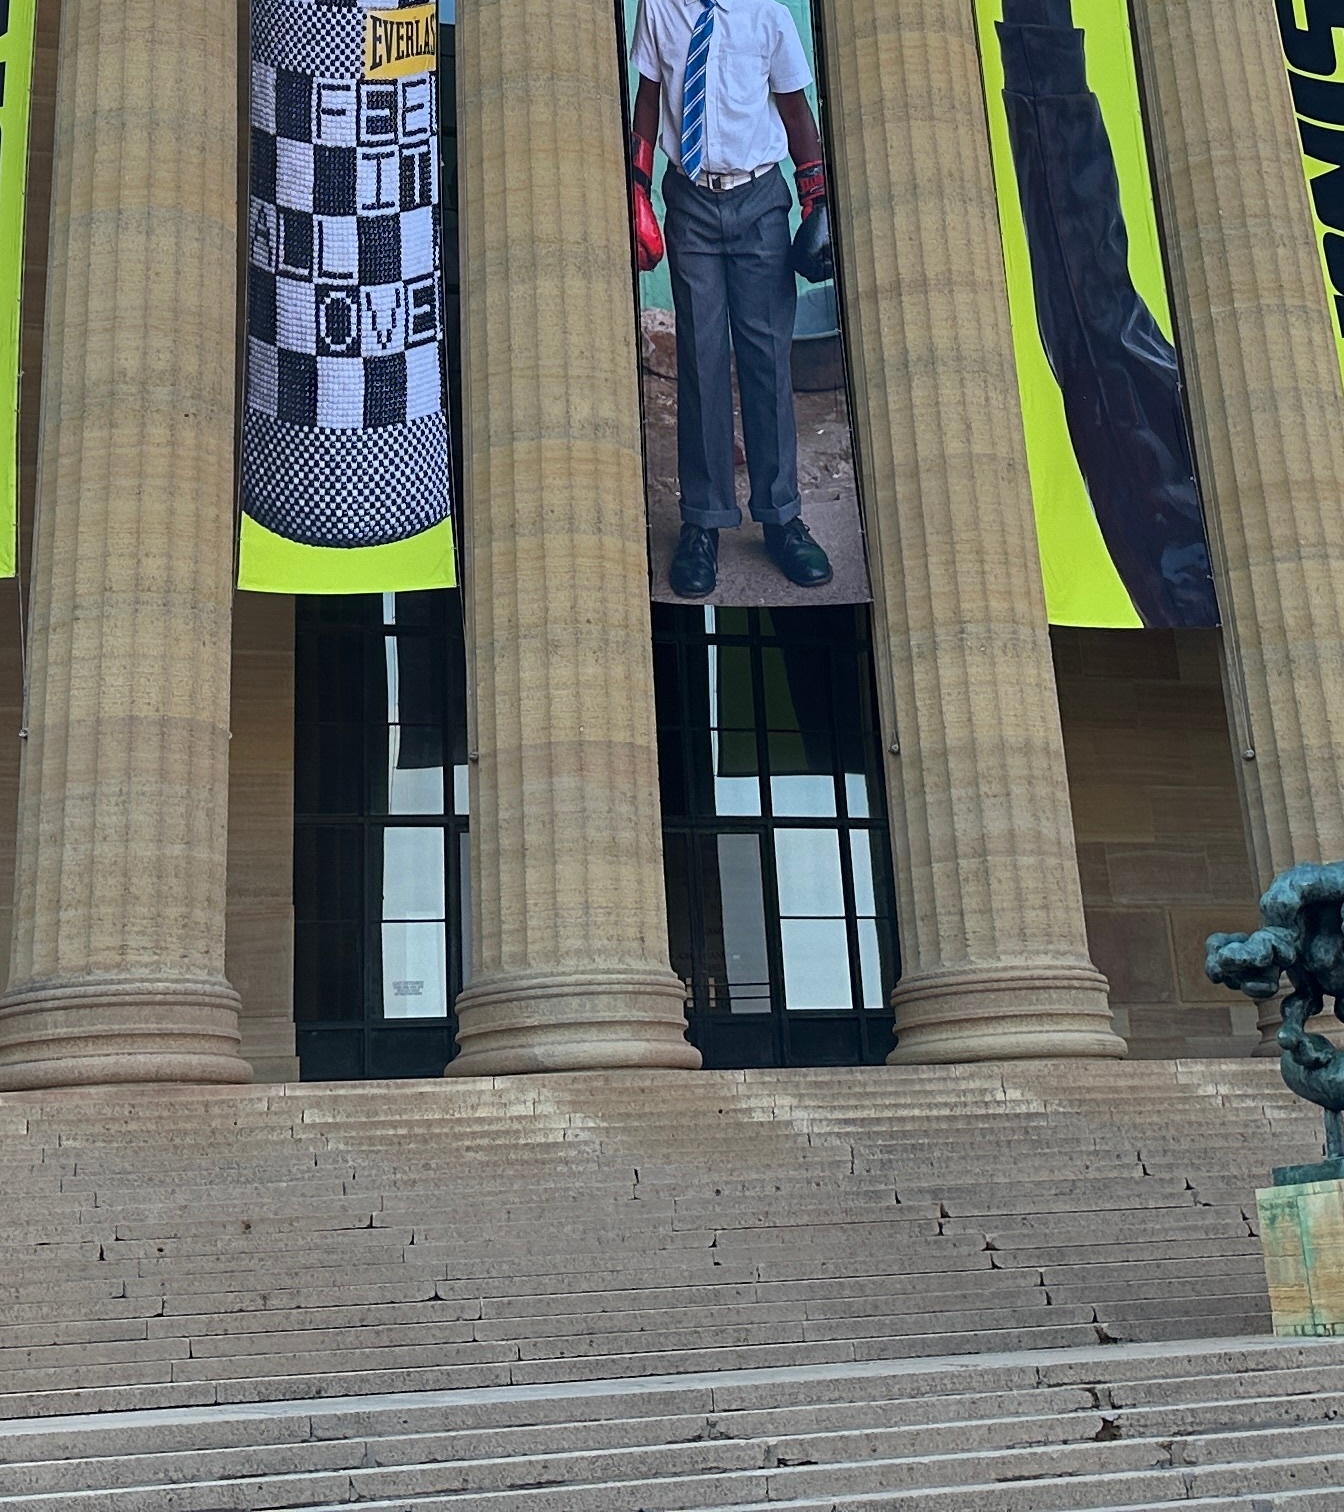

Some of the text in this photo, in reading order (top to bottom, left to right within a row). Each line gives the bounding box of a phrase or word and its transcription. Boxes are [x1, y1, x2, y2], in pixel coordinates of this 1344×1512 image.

[370, 13, 435, 71] EVERLAS
[362, 144, 429, 210] IT
[252, 206, 353, 279] ALL
